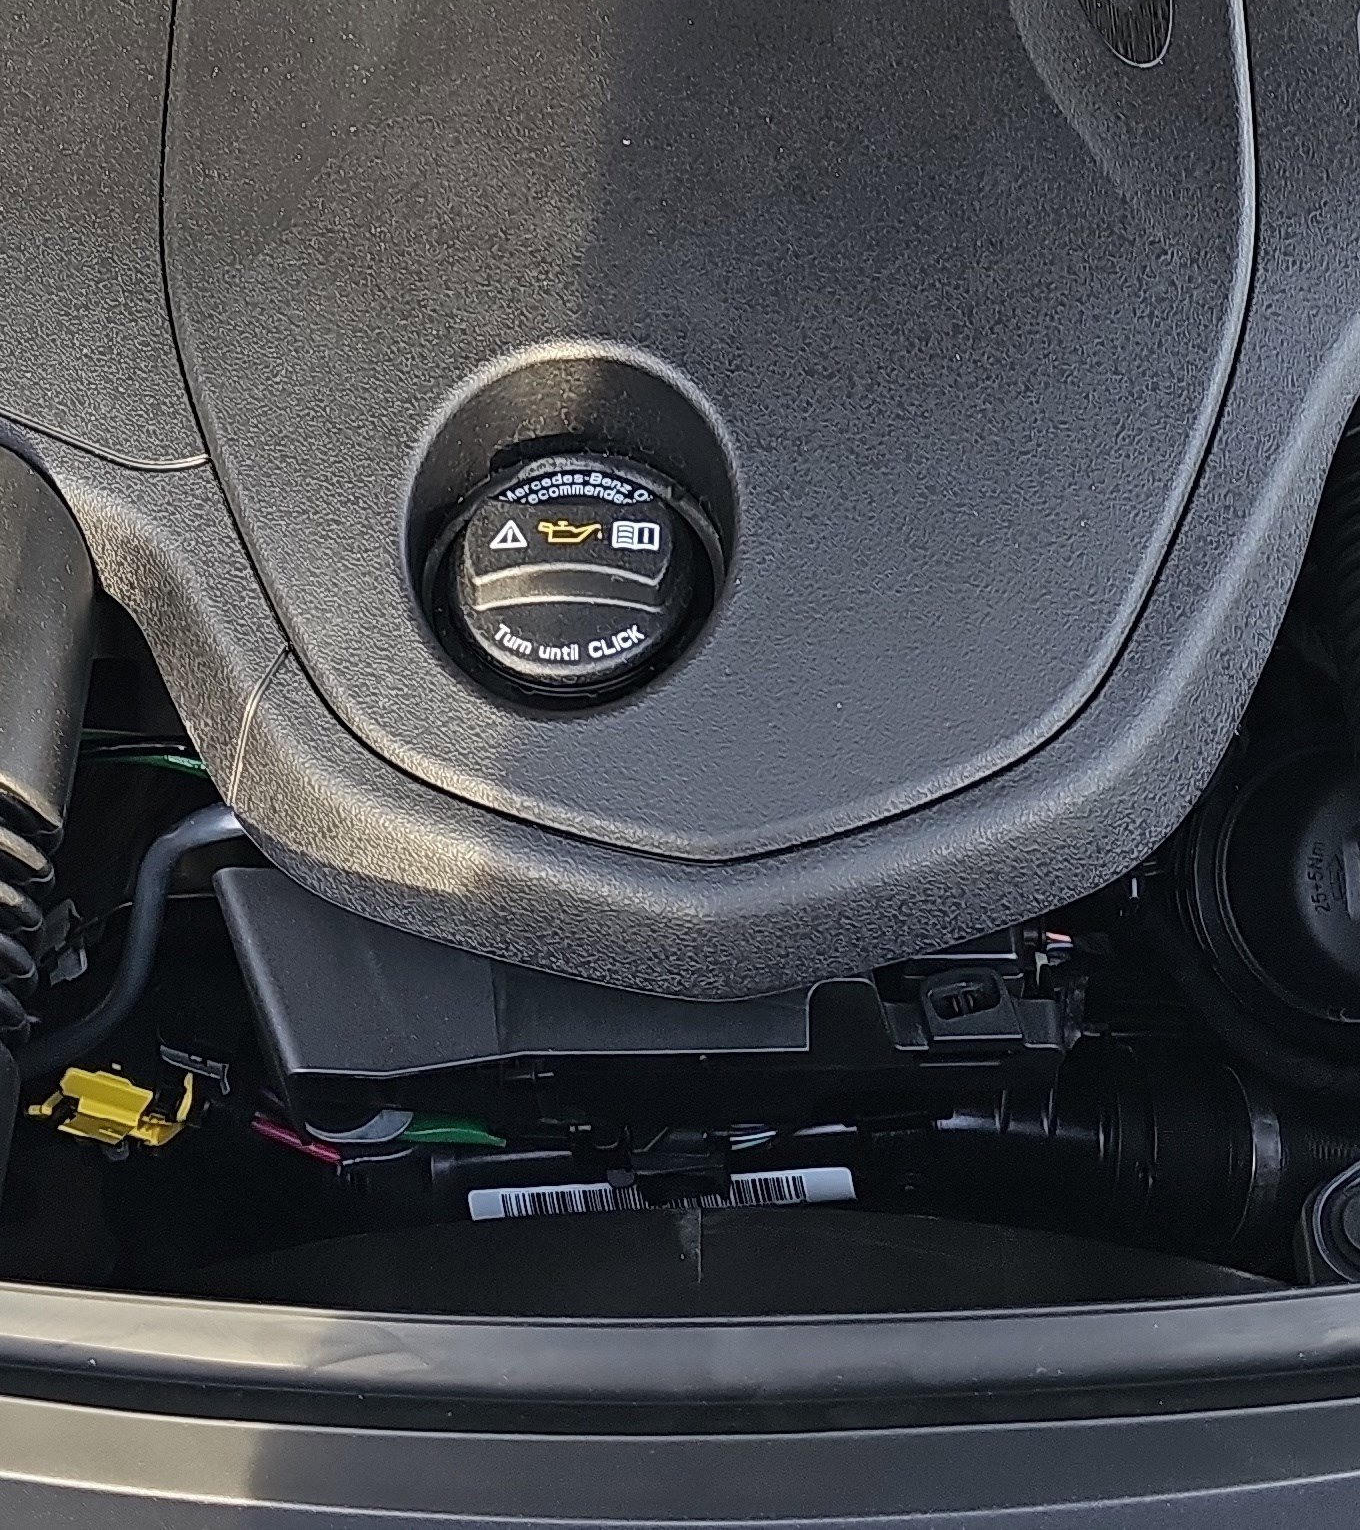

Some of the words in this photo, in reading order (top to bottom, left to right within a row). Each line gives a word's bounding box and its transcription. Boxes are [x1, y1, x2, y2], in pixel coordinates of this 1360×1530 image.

[494, 623, 533, 655] Turn
[538, 643, 579, 661] until
[588, 624, 646, 659] CLICK
